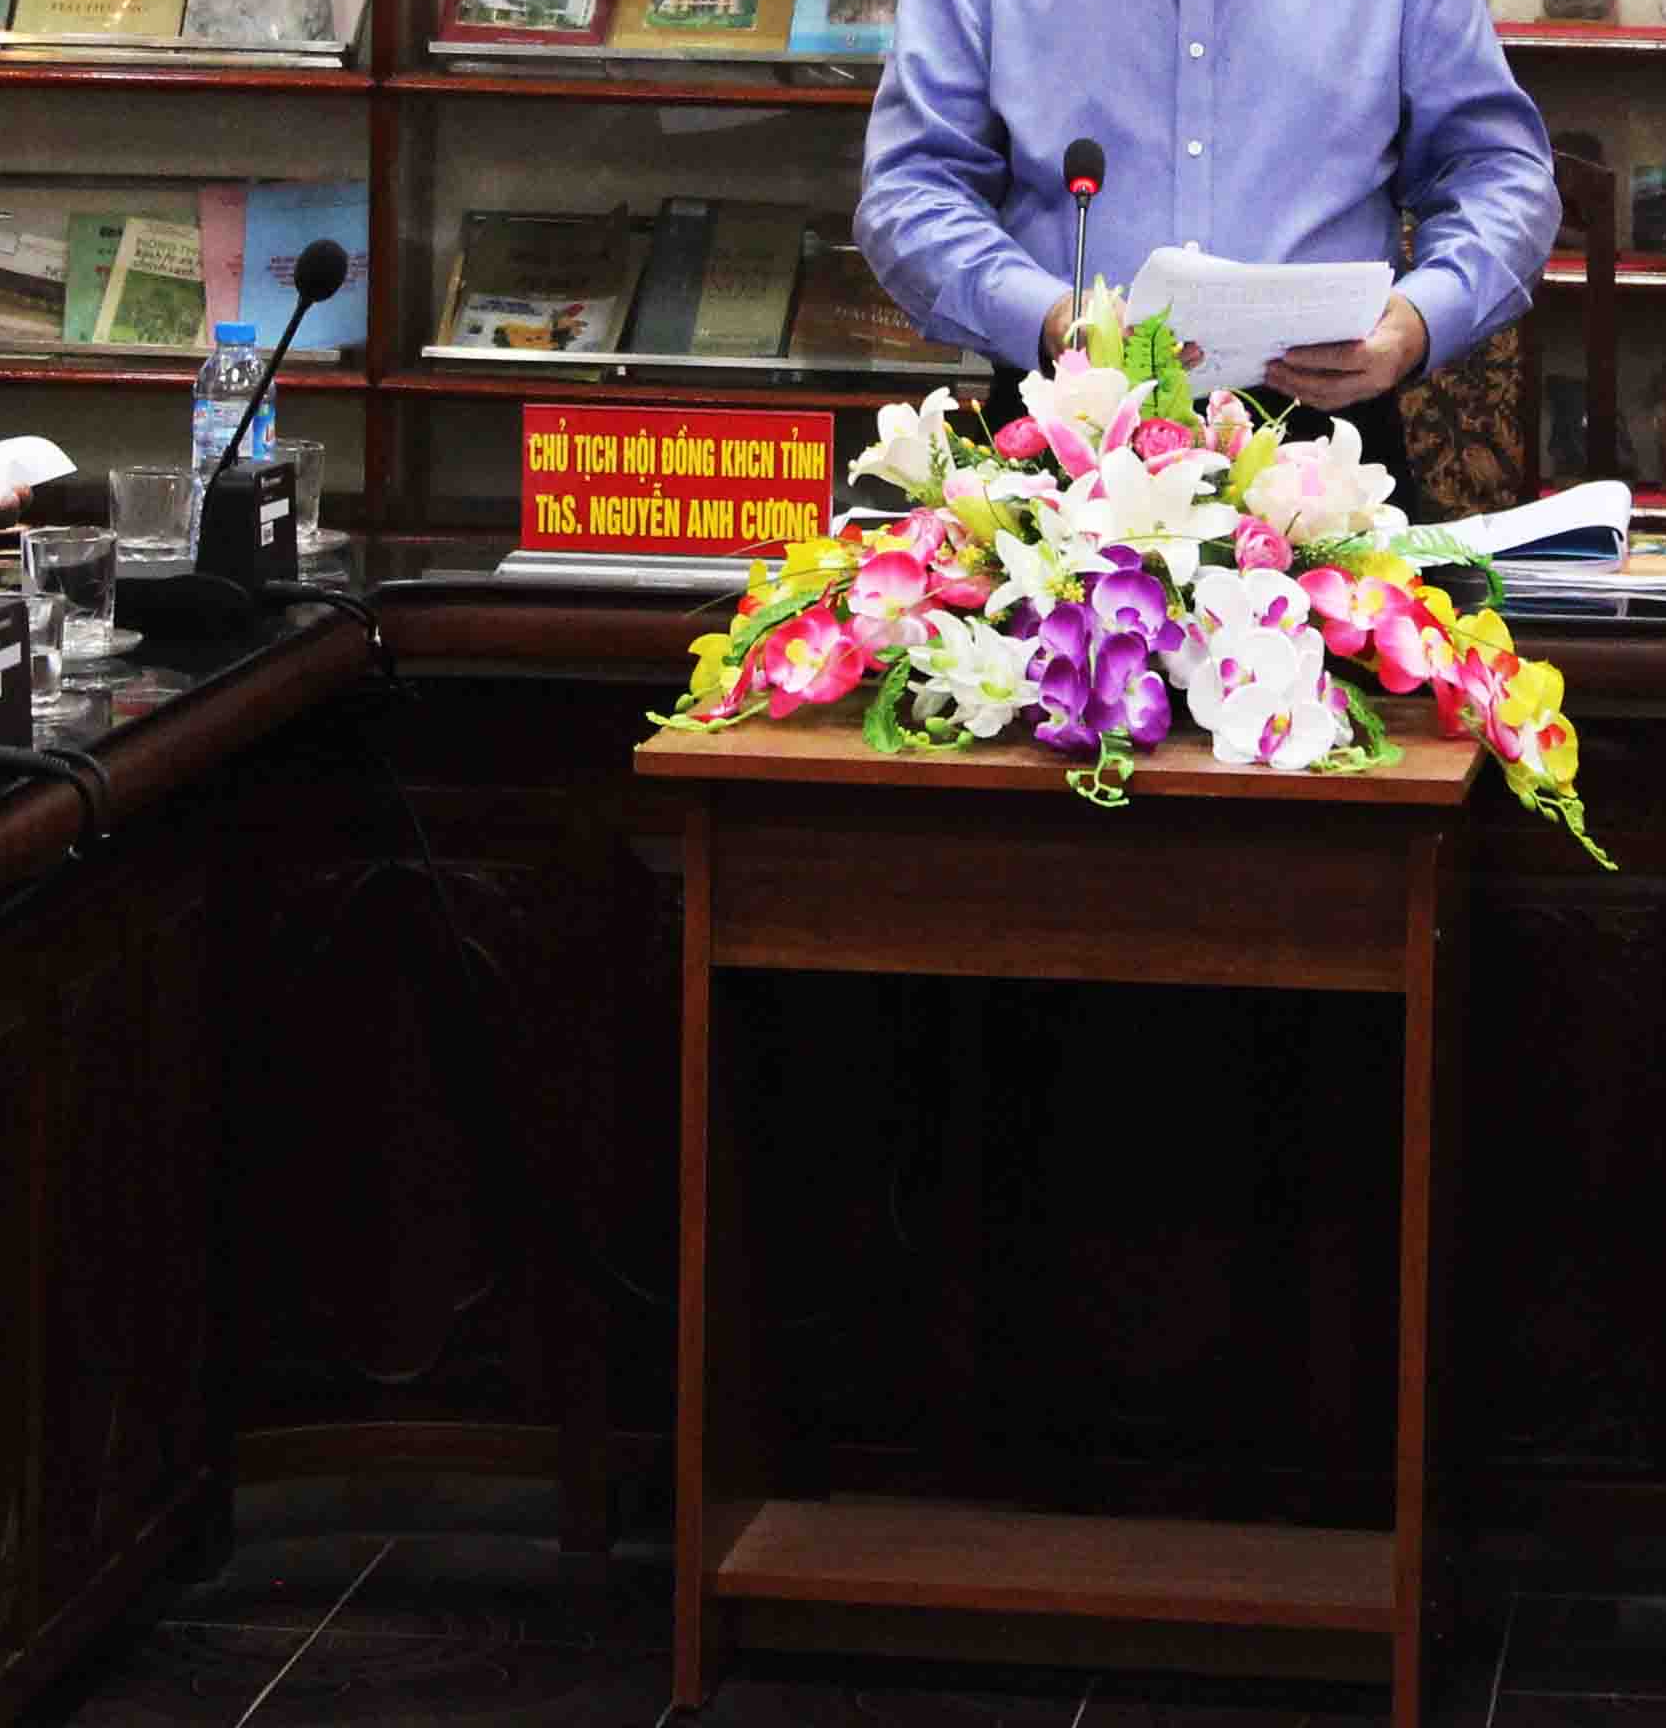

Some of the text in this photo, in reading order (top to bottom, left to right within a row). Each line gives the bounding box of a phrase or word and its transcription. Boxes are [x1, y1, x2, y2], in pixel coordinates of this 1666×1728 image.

[528, 418, 826, 484] CHỦ TỊCH HỘI ĐỒNG KHCN TỈNH
[535, 483, 819, 541] ThS. NGUYỄN ANH CƯƠNG
